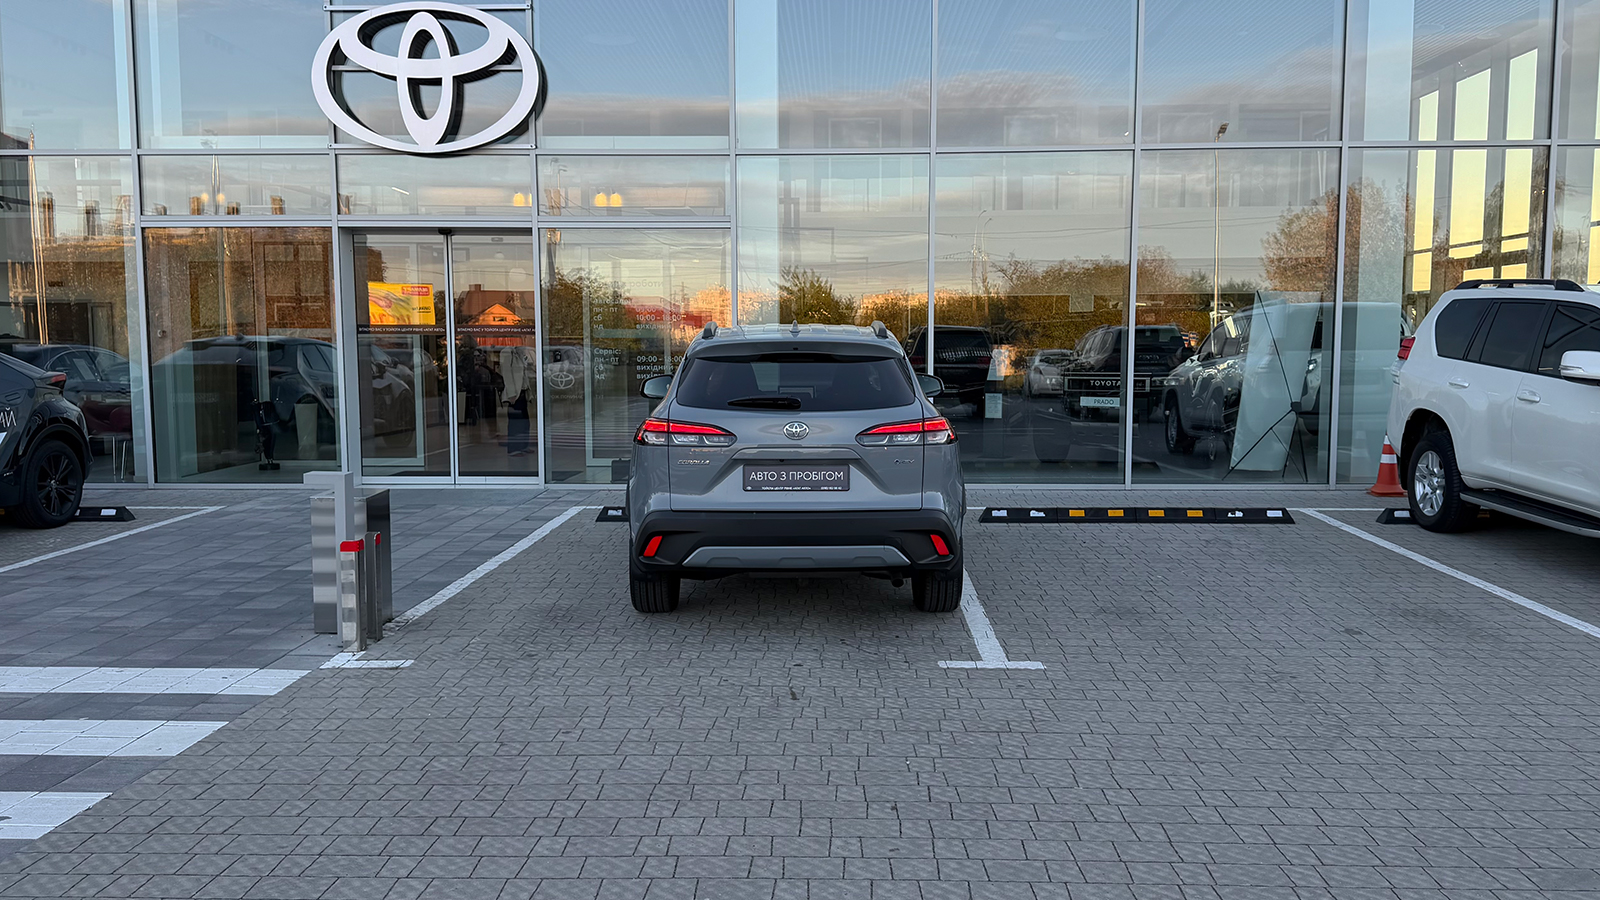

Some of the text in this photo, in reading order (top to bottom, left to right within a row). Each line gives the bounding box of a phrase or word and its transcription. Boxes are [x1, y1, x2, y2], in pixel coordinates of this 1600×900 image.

[593, 347, 622, 356] Сервіс:
[636, 355, 658, 363] 09:00
[636, 364, 674, 372] вихідний
[750, 471, 778, 481] АВТО
[789, 471, 844, 481] ПРОБІГОМ
